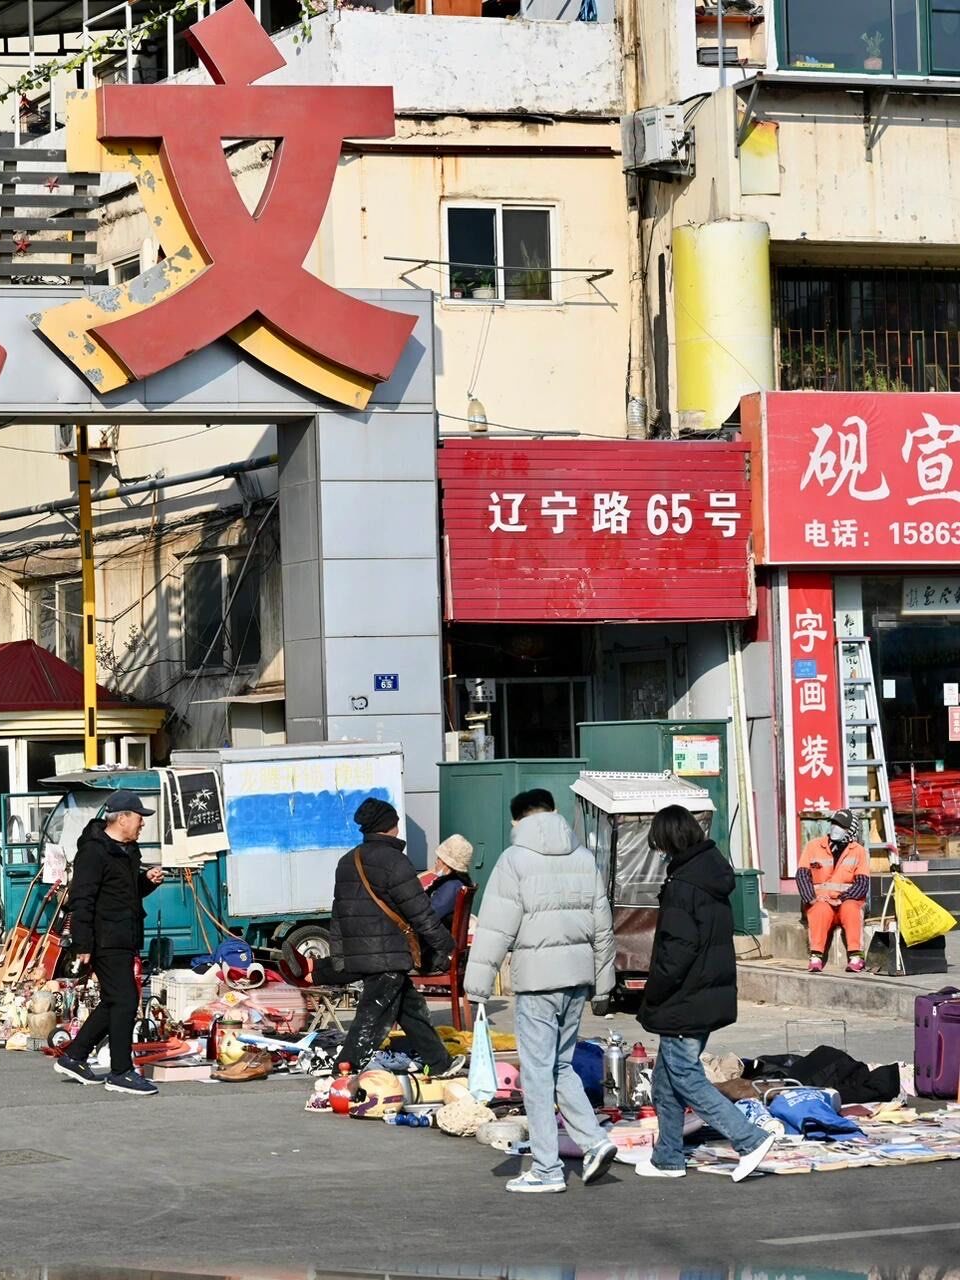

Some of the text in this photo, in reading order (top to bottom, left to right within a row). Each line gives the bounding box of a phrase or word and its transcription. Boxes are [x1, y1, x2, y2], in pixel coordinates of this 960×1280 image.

[488, 491, 741, 537] 辽宁路65号
[889, 521, 960, 545] 15863
